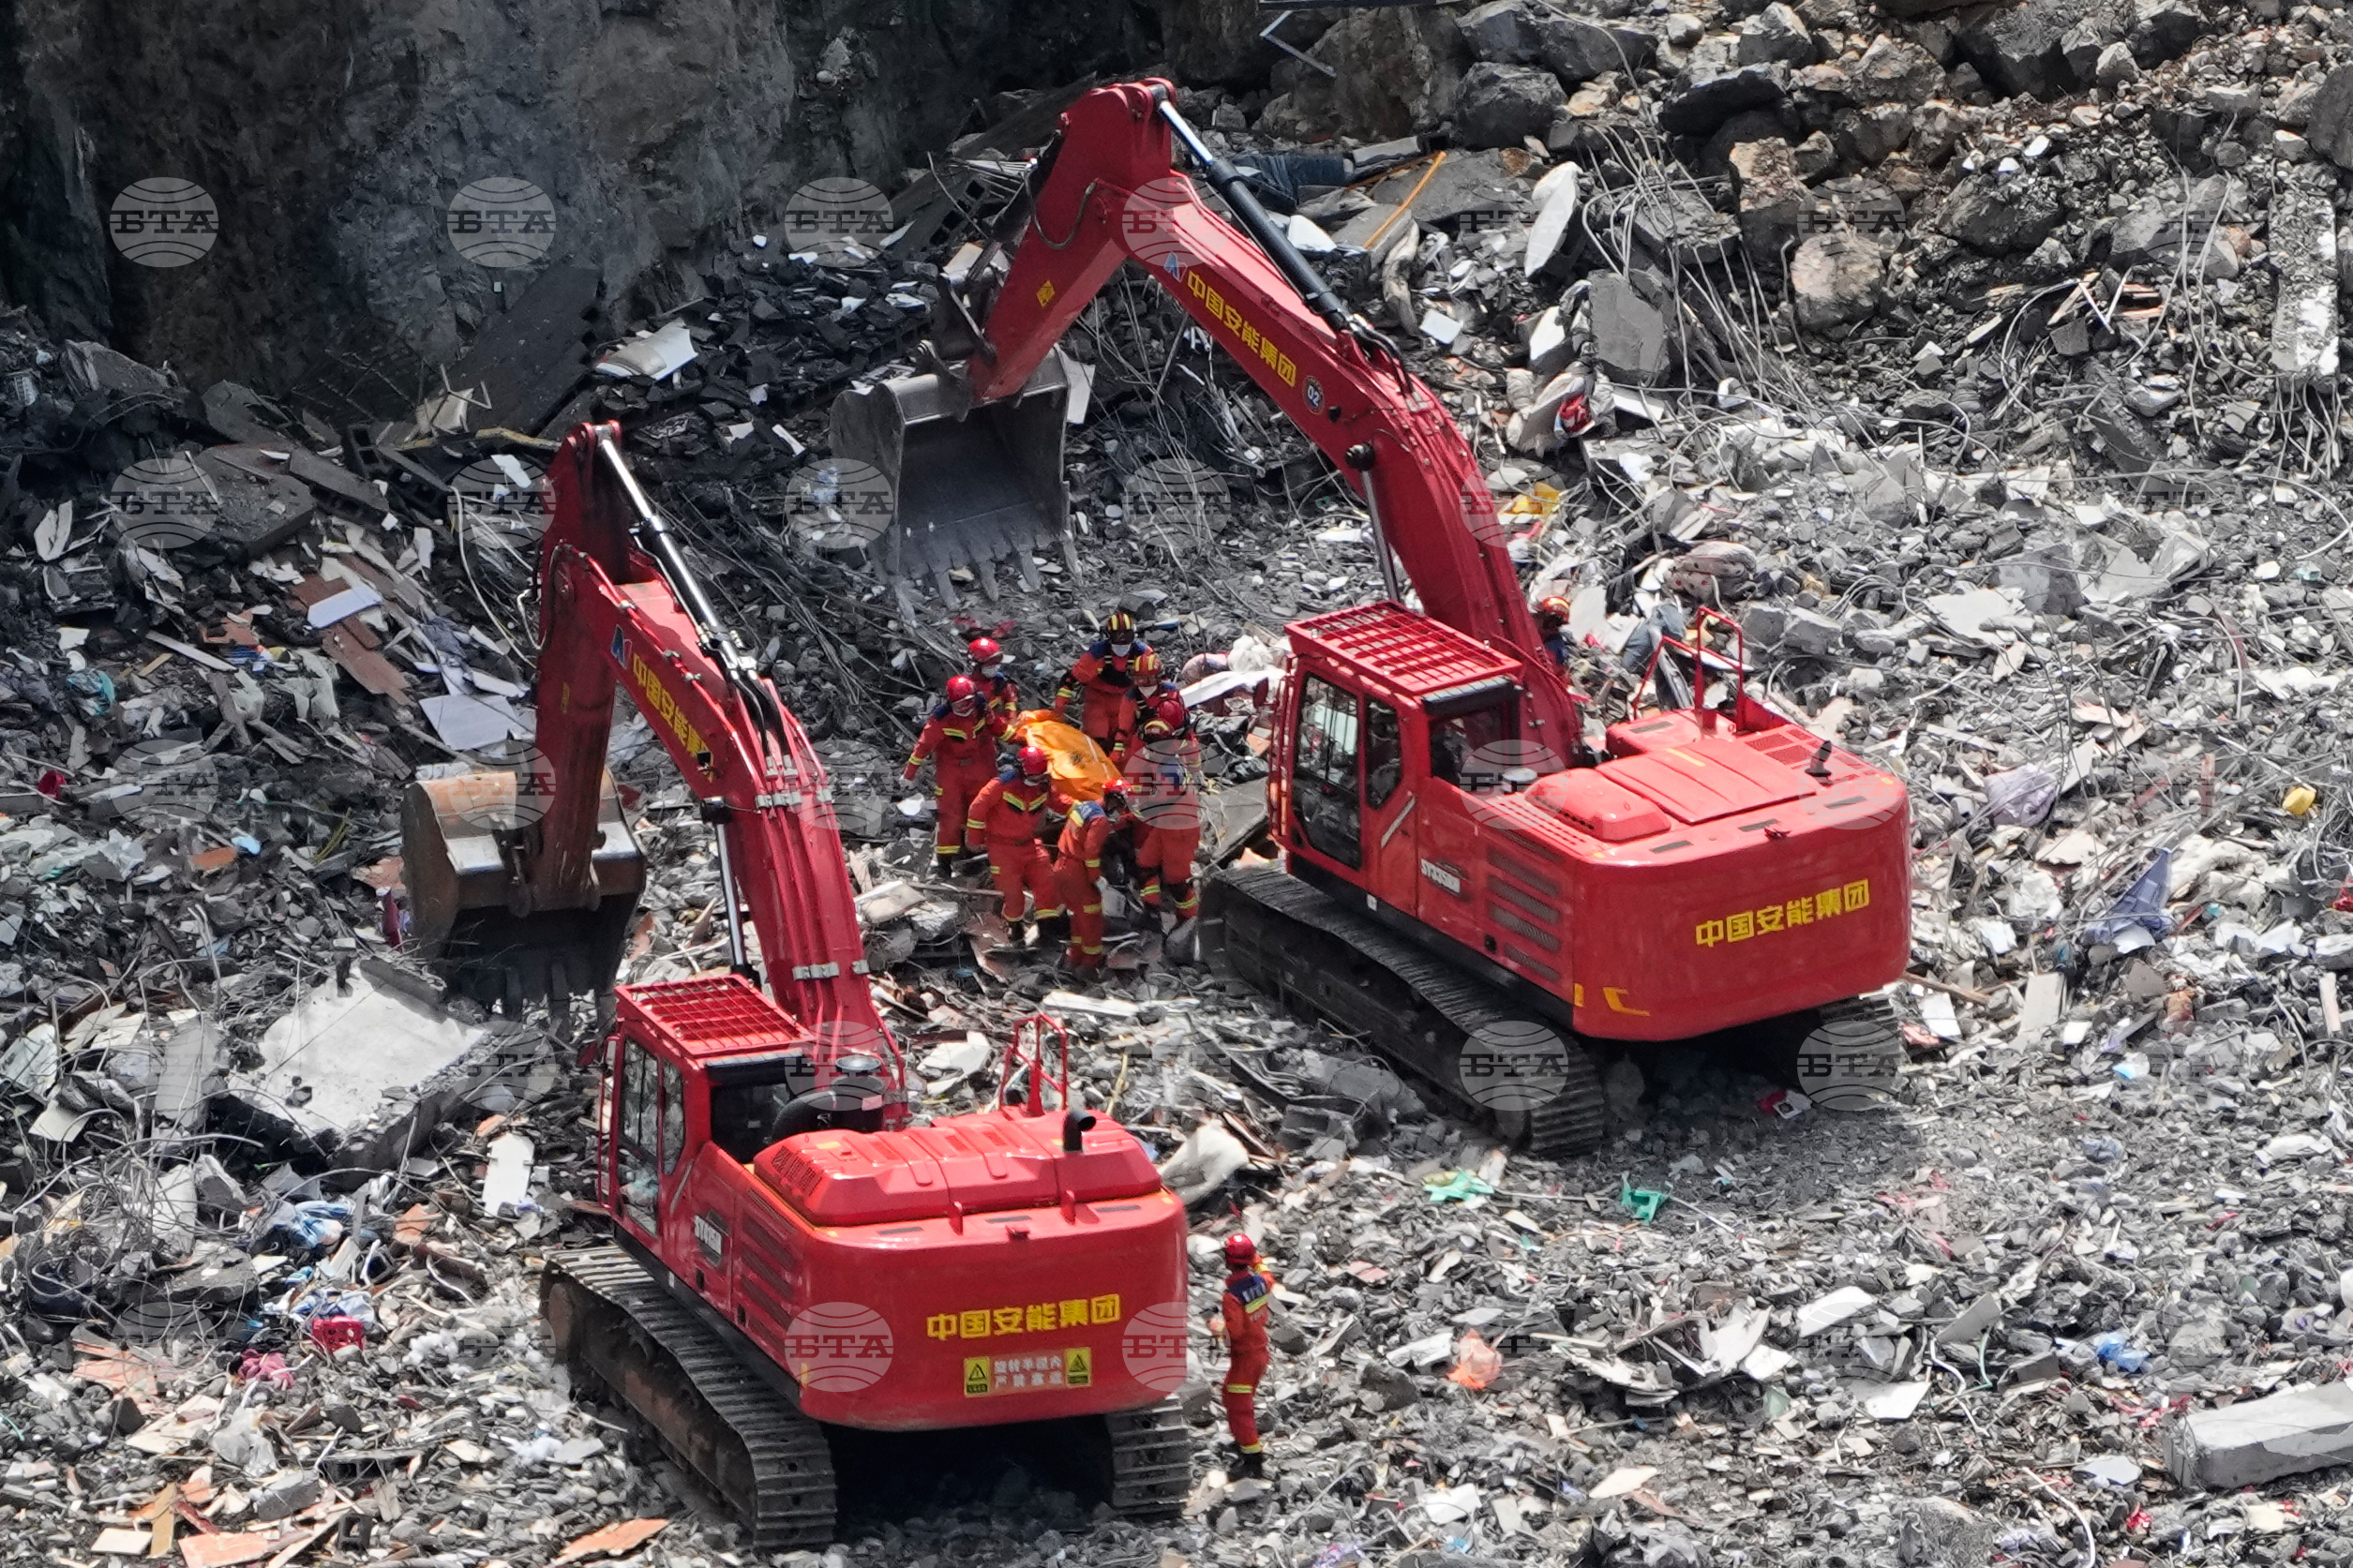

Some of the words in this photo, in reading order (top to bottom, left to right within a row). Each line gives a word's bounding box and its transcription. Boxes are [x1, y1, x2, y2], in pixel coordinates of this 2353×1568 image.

[1187, 270, 1296, 387] 中国安能集团
[1695, 877, 1870, 948] 中国安能集团
[926, 1292, 1120, 1341] 中国安能集团
